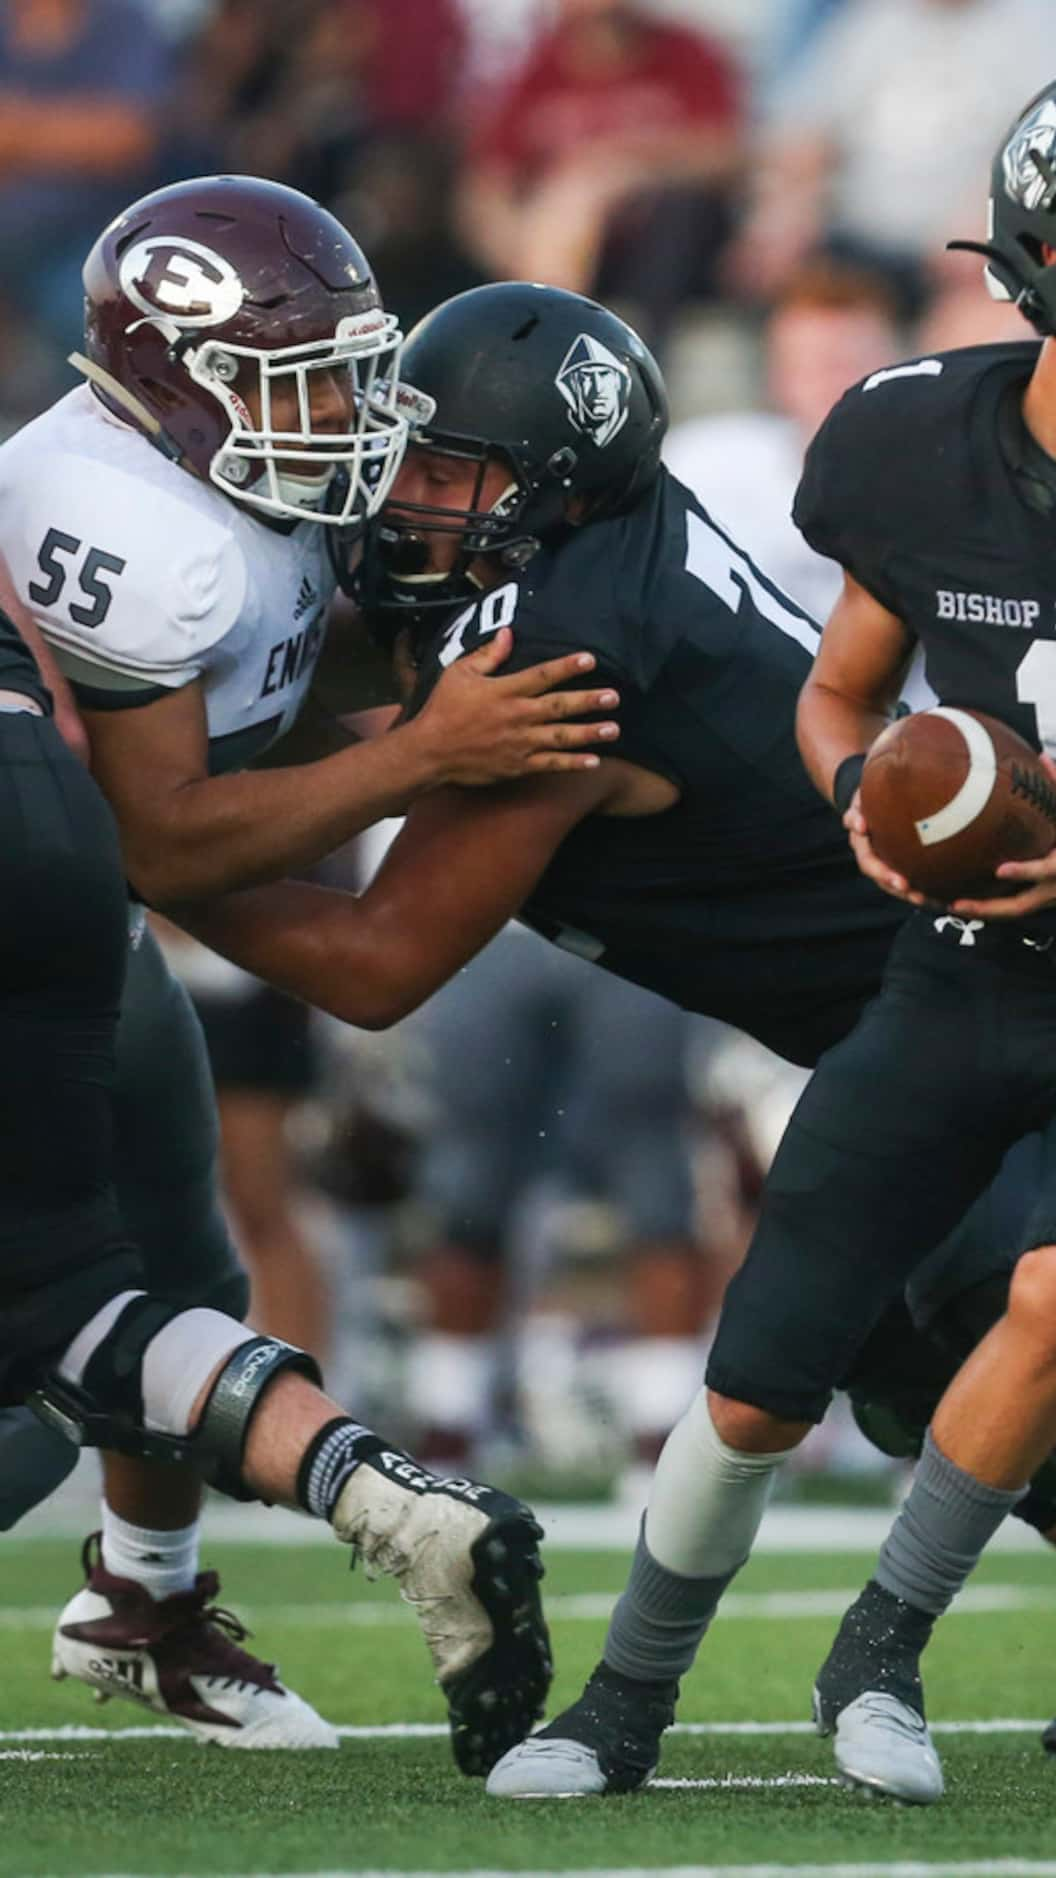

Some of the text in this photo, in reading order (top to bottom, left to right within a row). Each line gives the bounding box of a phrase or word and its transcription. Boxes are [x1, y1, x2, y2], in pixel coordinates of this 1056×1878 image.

[863, 359, 943, 392] 1
[28, 527, 128, 629] 55
[936, 590, 1040, 628] BISHOP
